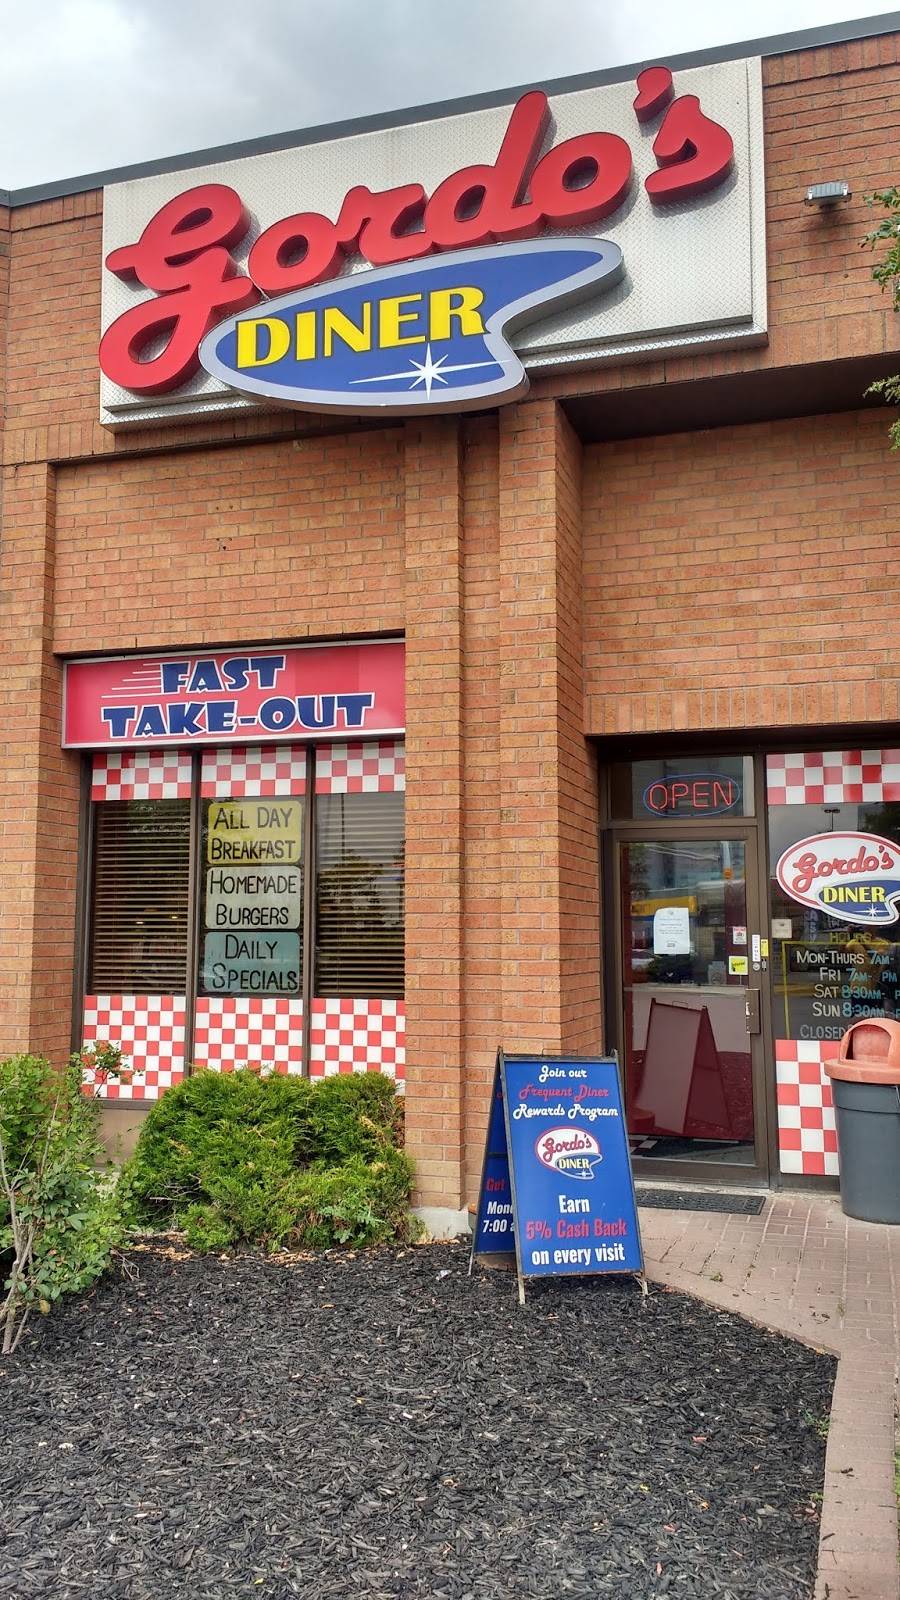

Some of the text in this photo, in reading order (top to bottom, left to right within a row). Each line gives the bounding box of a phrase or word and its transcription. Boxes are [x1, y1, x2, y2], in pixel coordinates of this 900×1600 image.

[99, 66, 735, 396] Gordo's
[235, 285, 487, 369] DINER
[160, 655, 286, 694] FAST
[101, 693, 375, 739] TAKE-OUT
[649, 781, 732, 811] OPEN
[213, 806, 293, 830] ALL DAY
[211, 838, 296, 860] BREAKFAST
[792, 845, 895, 893] Gordo's
[210, 870, 297, 895] HOMEMADE
[823, 886, 886, 903] DINER
[216, 903, 289, 926] BURGERS
[224, 934, 278, 960] DAILY
[796, 950, 865, 964] MON-THURS
[212, 962, 298, 991] SPECIALS
[820, 967, 840, 981] FRI
[814, 984, 839, 998] SAT
[812, 1002, 840, 1017] SUN
[800, 1024, 846, 1040] CLOSED
[538, 1065, 588, 1083] Join our
[518, 1083, 573, 1102] Frequent
[574, 1084, 609, 1103] Diner
[512, 1103, 619, 1121] Rewards Program
[542, 1133, 593, 1163] Gordo's
[559, 1158, 590, 1170] DINER
[558, 1194, 590, 1214] Earn
[482, 1219, 508, 1234] 7:00
[526, 1218, 627, 1240] 5% Cash Back
[531, 1242, 626, 1266] on every visit
